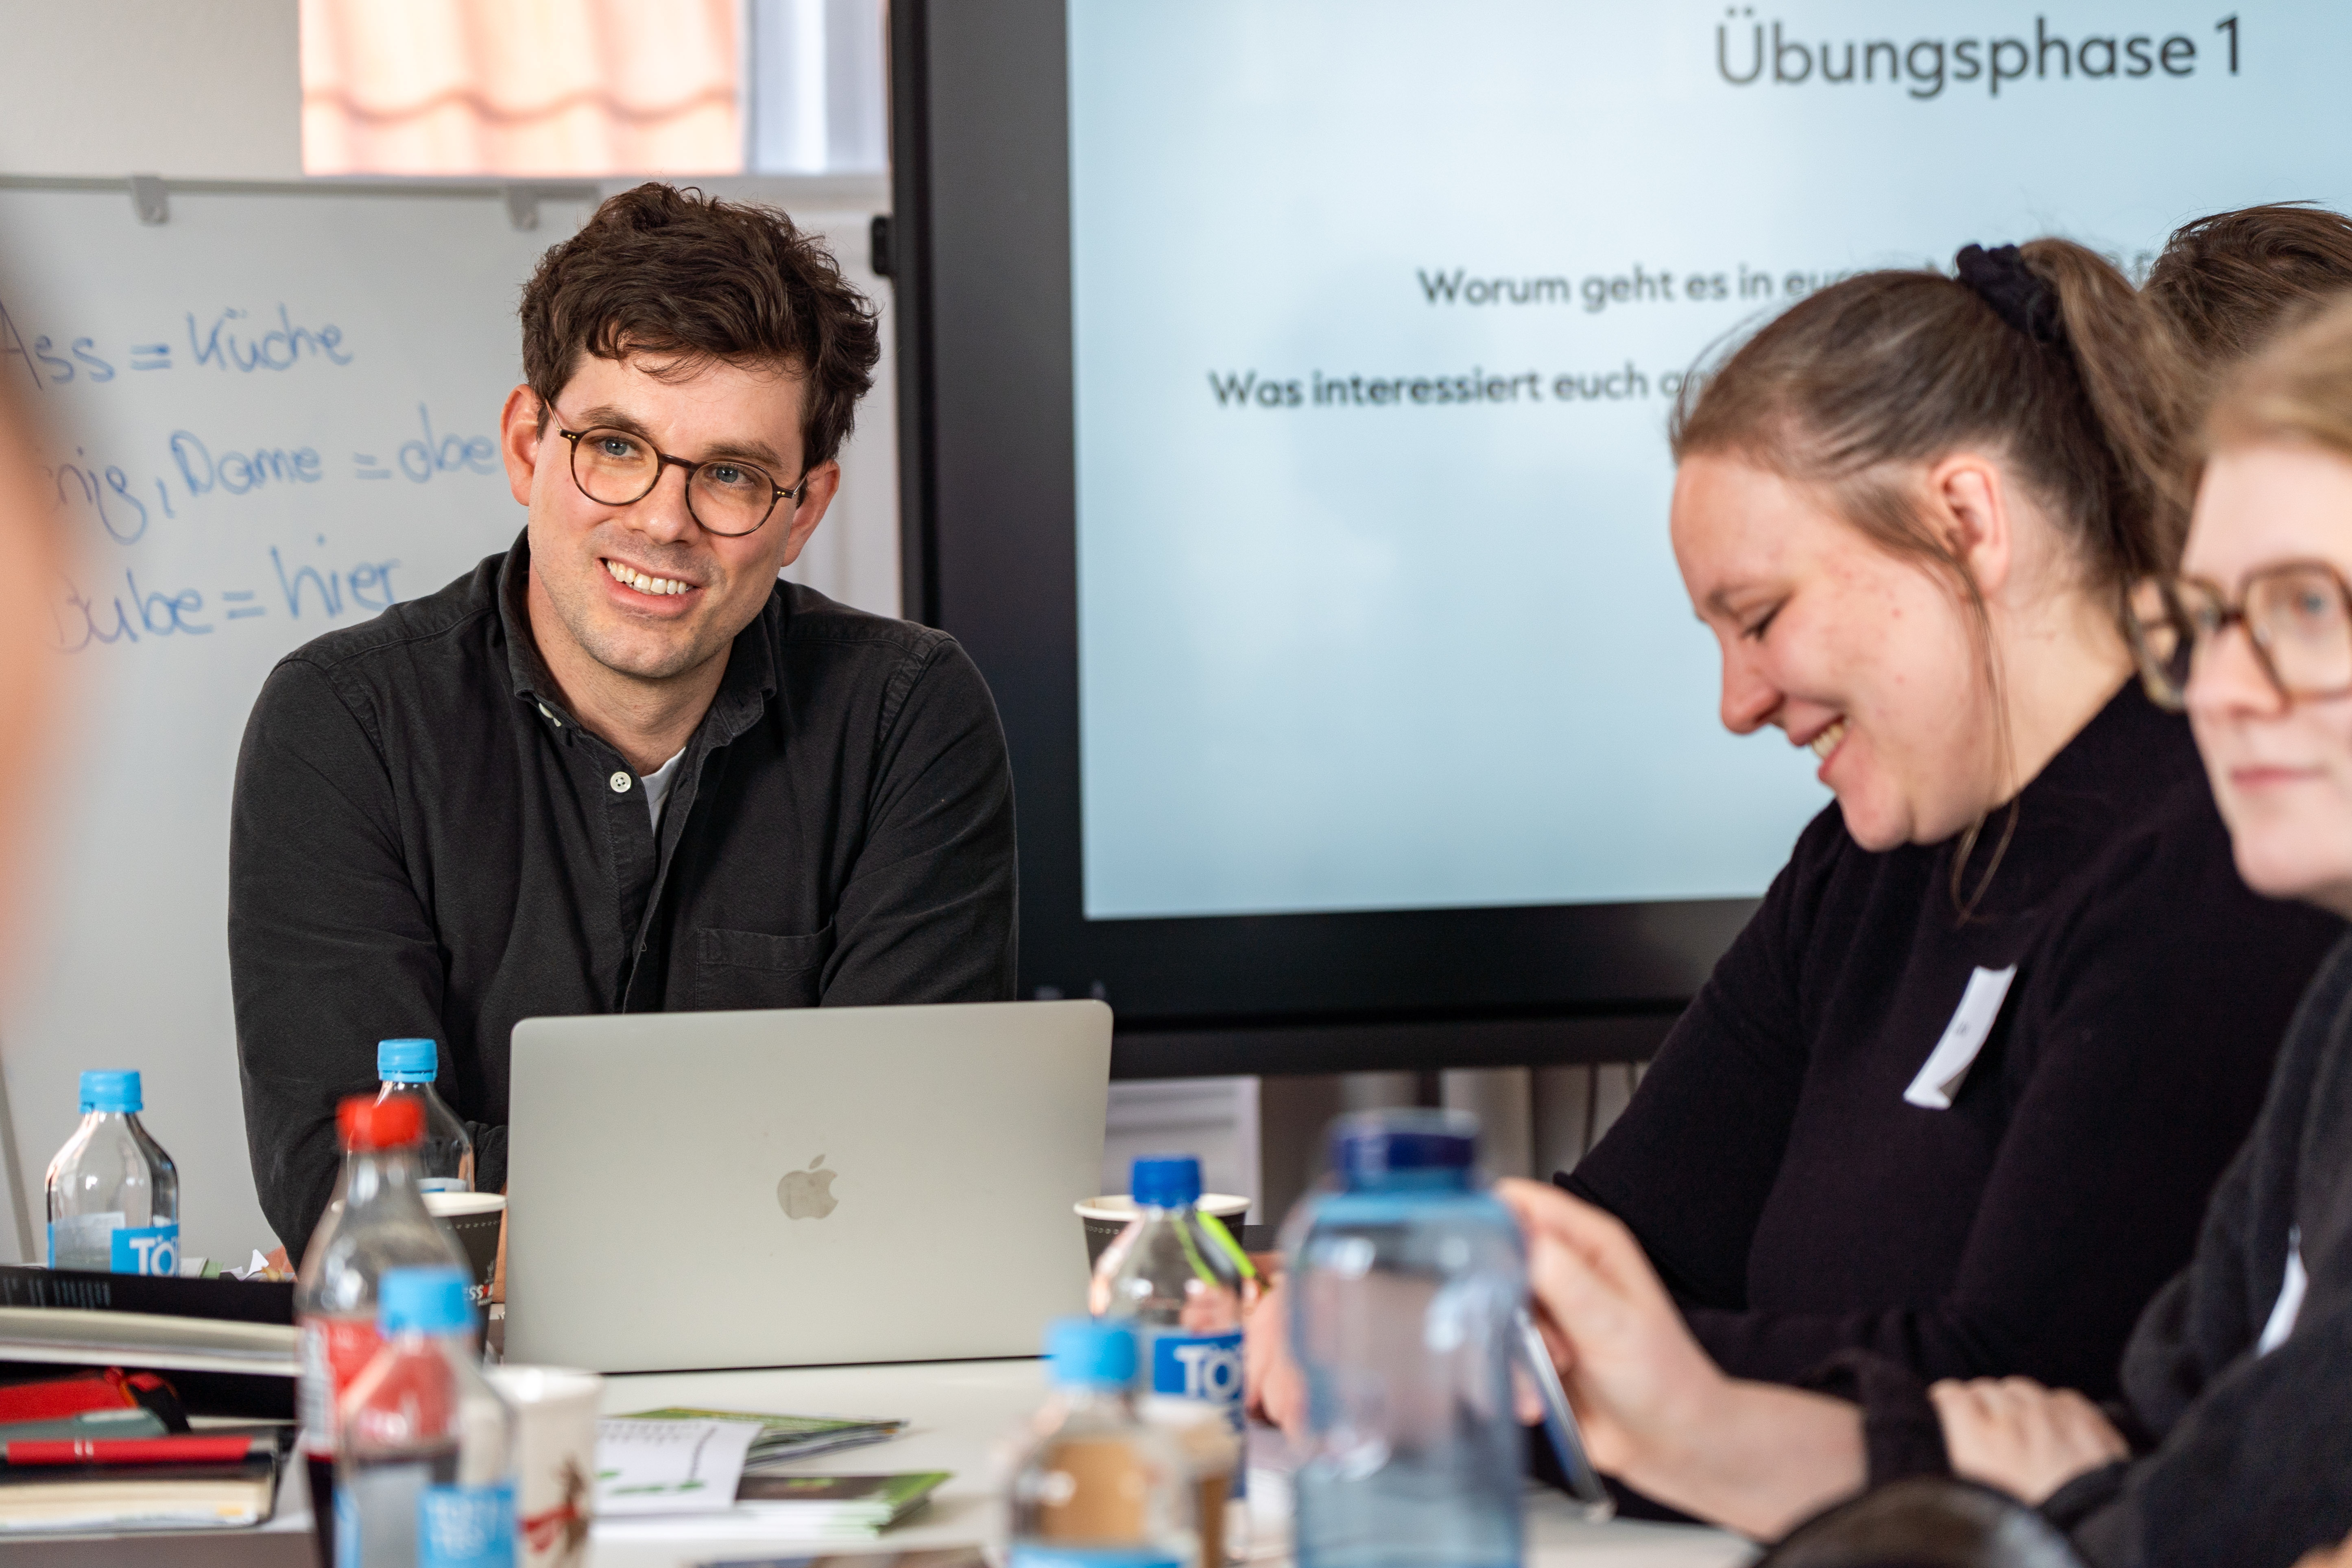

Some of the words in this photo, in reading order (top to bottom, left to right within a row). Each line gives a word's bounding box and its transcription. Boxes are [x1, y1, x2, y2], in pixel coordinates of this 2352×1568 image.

[1716, 7, 2199, 100] Übungsphase
[2214, 13, 2240, 76] 1
[1416, 267, 1571, 307] Worum
[1580, 263, 1675, 313] geht
[1683, 271, 1729, 302] es
[1737, 262, 1774, 301] in
[185, 303, 355, 372] Küche
[1207, 369, 1305, 409] Was
[1310, 367, 1540, 408] interessiert
[1551, 360, 1650, 401] euch
[398, 402, 500, 484] obe
[270, 534, 401, 620] hier
